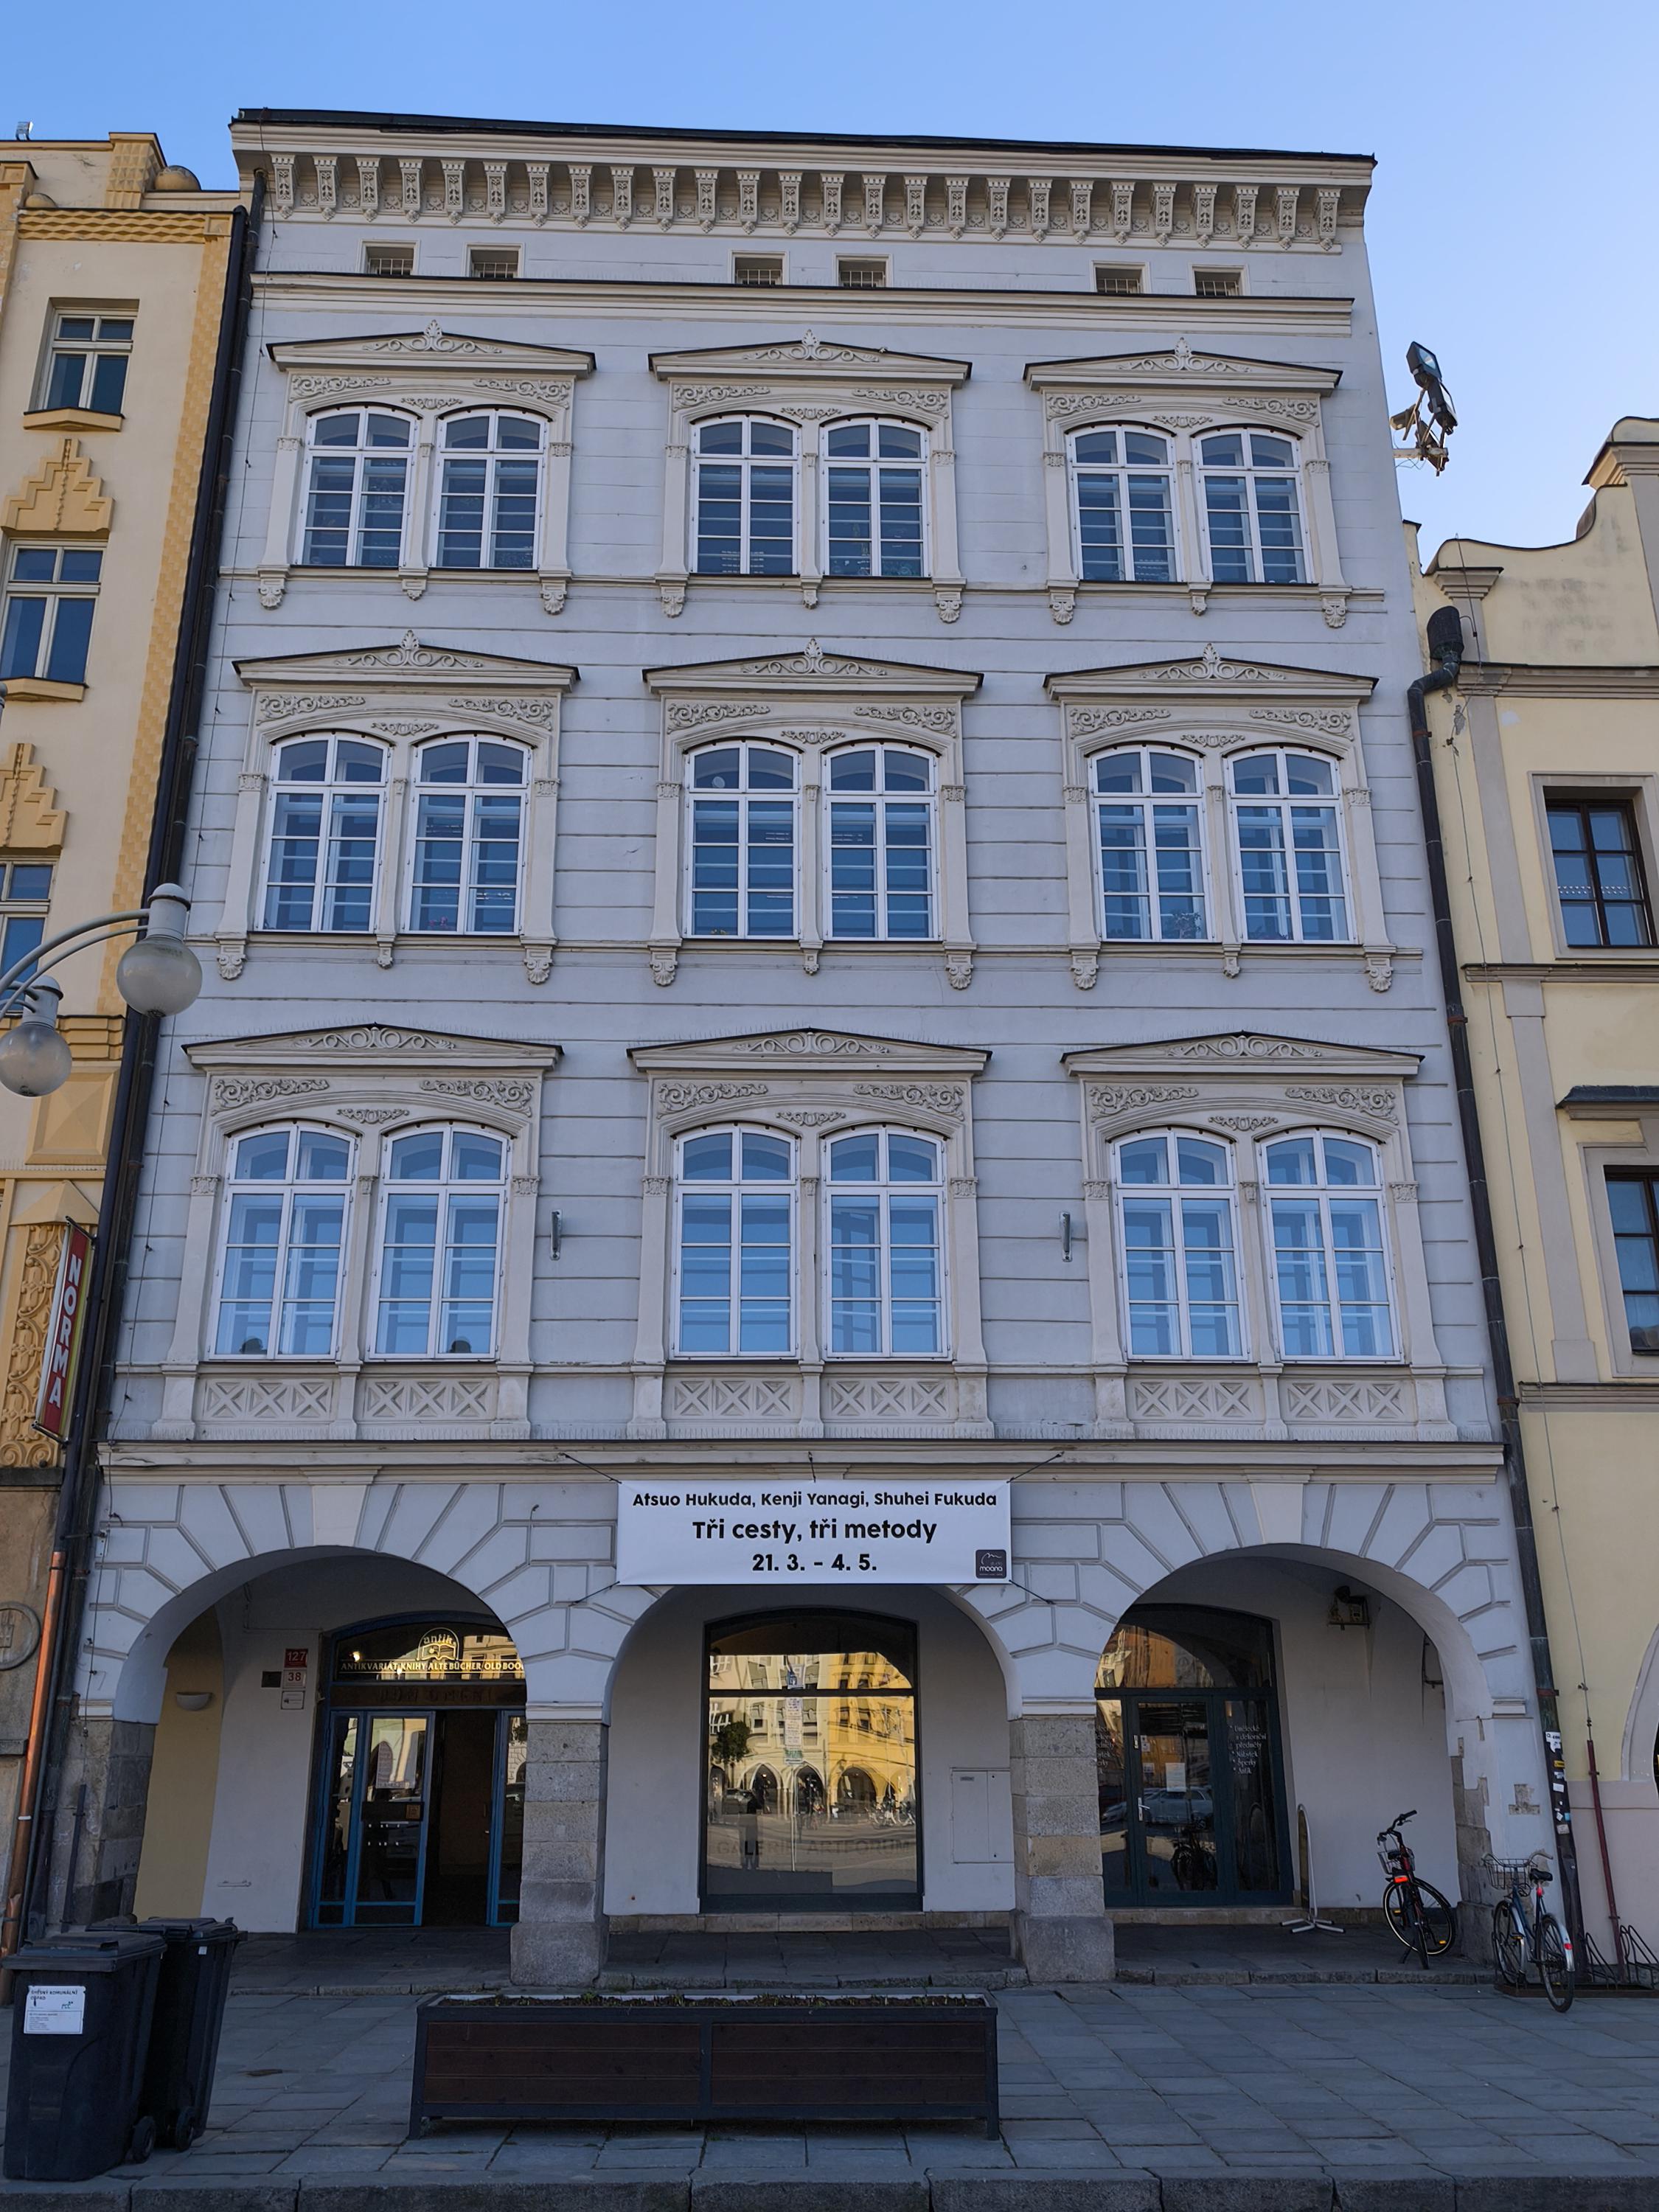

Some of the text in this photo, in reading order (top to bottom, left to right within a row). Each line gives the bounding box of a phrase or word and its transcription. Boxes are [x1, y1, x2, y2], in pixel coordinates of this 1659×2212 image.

[49, 1254, 82, 1408] NORMA
[633, 1490, 997, 1509] Atsuo Hukuda, Kenji Yanagi, Shuhei Fukuda
[692, 1518, 937, 1544] Tři cesty, tři metody
[752, 1554, 779, 1571] 21.
[787, 1554, 805, 1571] 3.
[831, 1554, 851, 1571] 4.
[858, 1553, 877, 1571] 5.
[288, 1651, 306, 1661] 127
[449, 1661, 481, 1670] BÜCHER
[288, 1672, 302, 1682] 38
